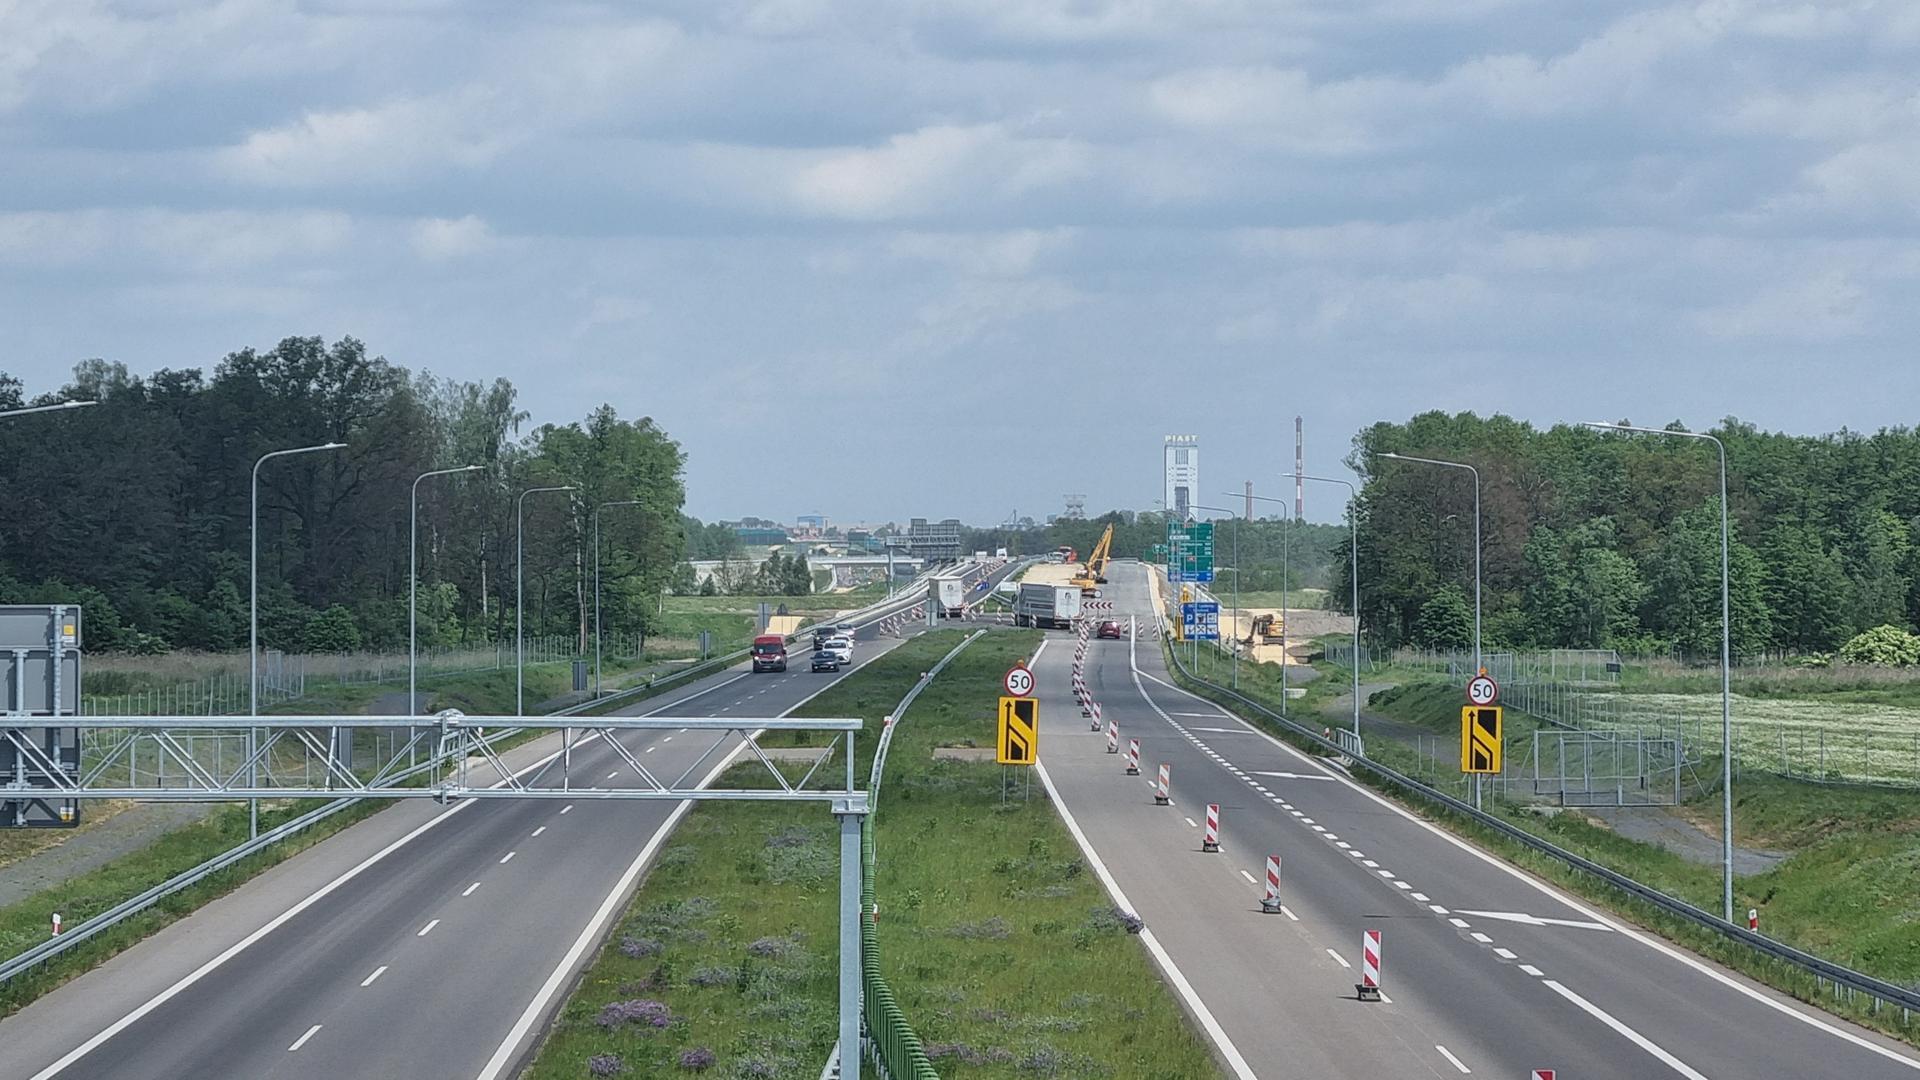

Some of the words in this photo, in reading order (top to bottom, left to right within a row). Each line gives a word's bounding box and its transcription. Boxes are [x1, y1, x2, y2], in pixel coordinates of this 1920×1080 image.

[1164, 434, 1198, 443] PIAST
[1186, 614, 1194, 623] P
[1009, 674, 1030, 690] 50
[1472, 683, 1493, 699] 50
